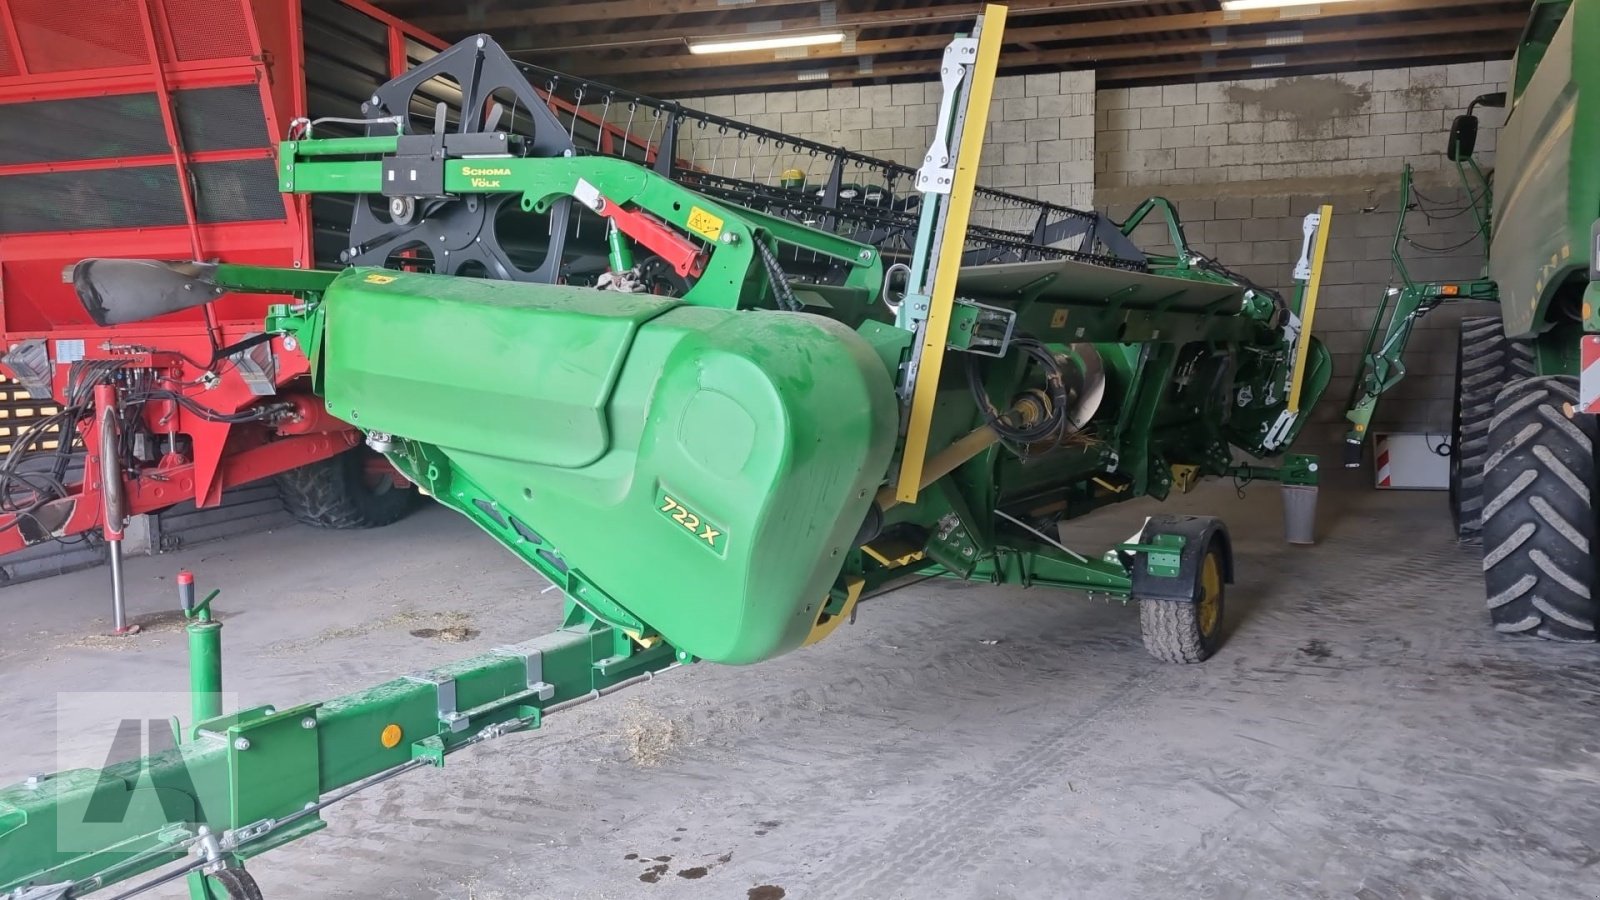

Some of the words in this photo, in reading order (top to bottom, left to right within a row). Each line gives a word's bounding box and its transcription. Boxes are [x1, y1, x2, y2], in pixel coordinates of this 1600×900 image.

[462, 166, 511, 176] SCHOMA
[660, 495, 700, 533] 722
[699, 523, 721, 546] X
